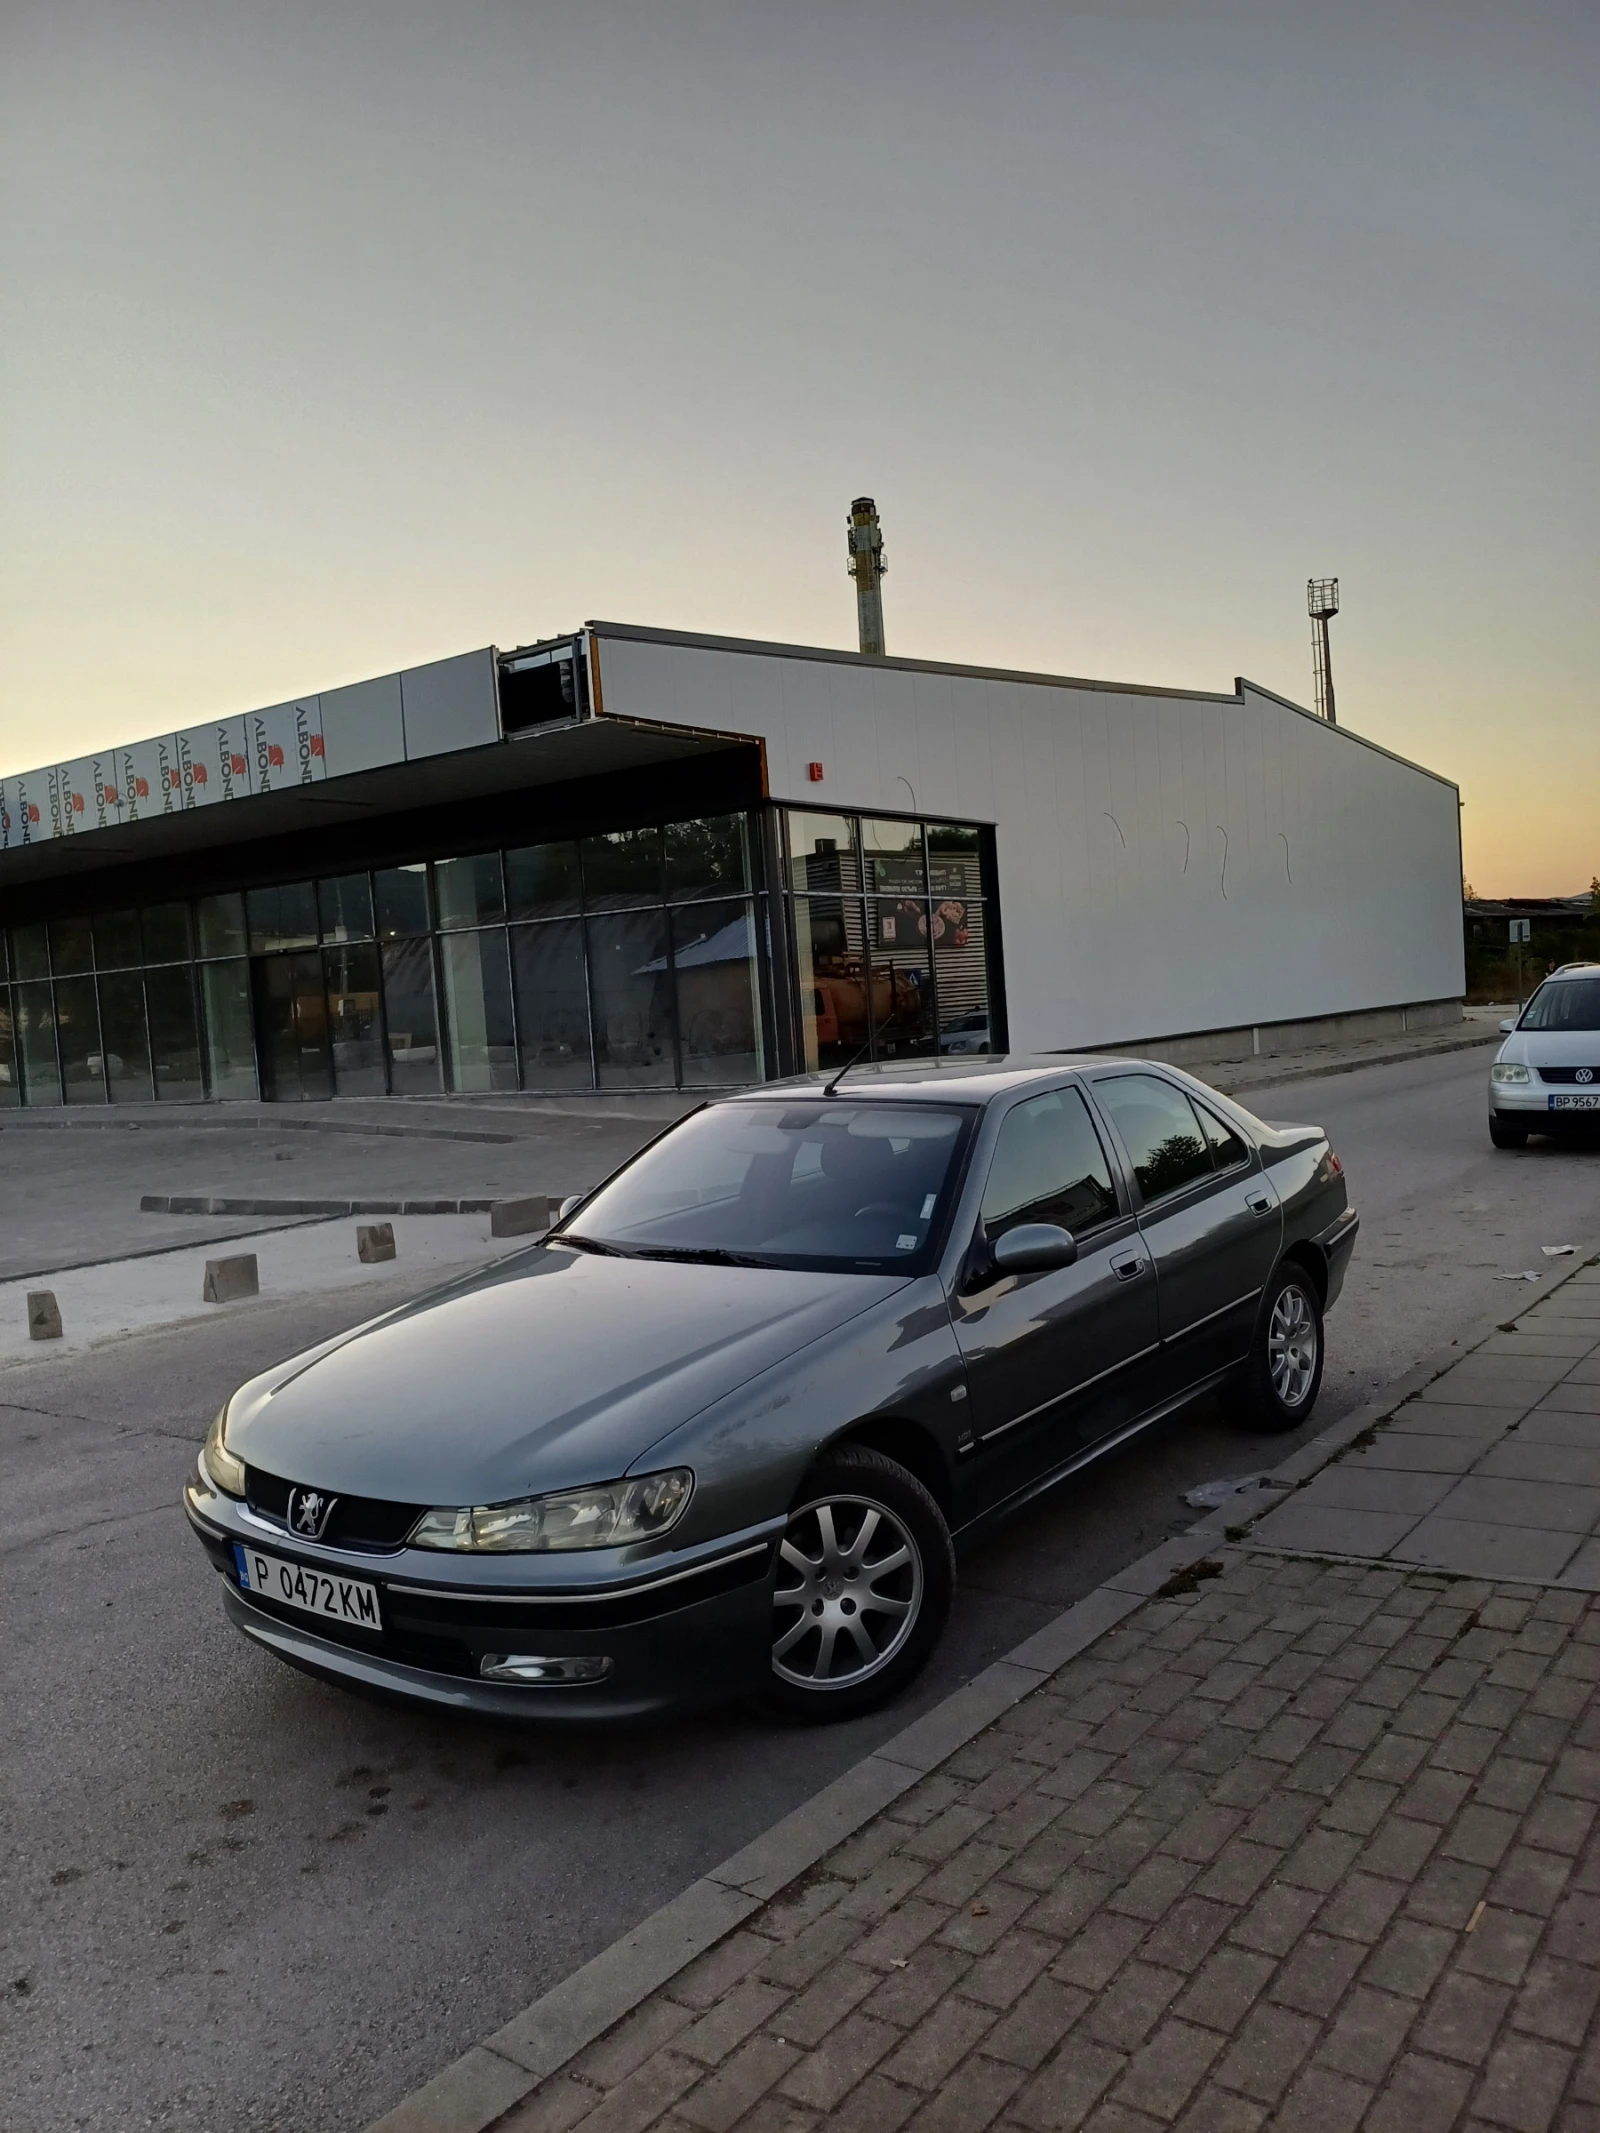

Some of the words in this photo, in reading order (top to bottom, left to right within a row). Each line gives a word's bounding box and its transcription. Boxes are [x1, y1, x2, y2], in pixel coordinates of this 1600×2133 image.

[1556, 1097, 1570, 1107] BP
[1572, 1097, 1599, 1107] 9567
[255, 1556, 268, 1589] P
